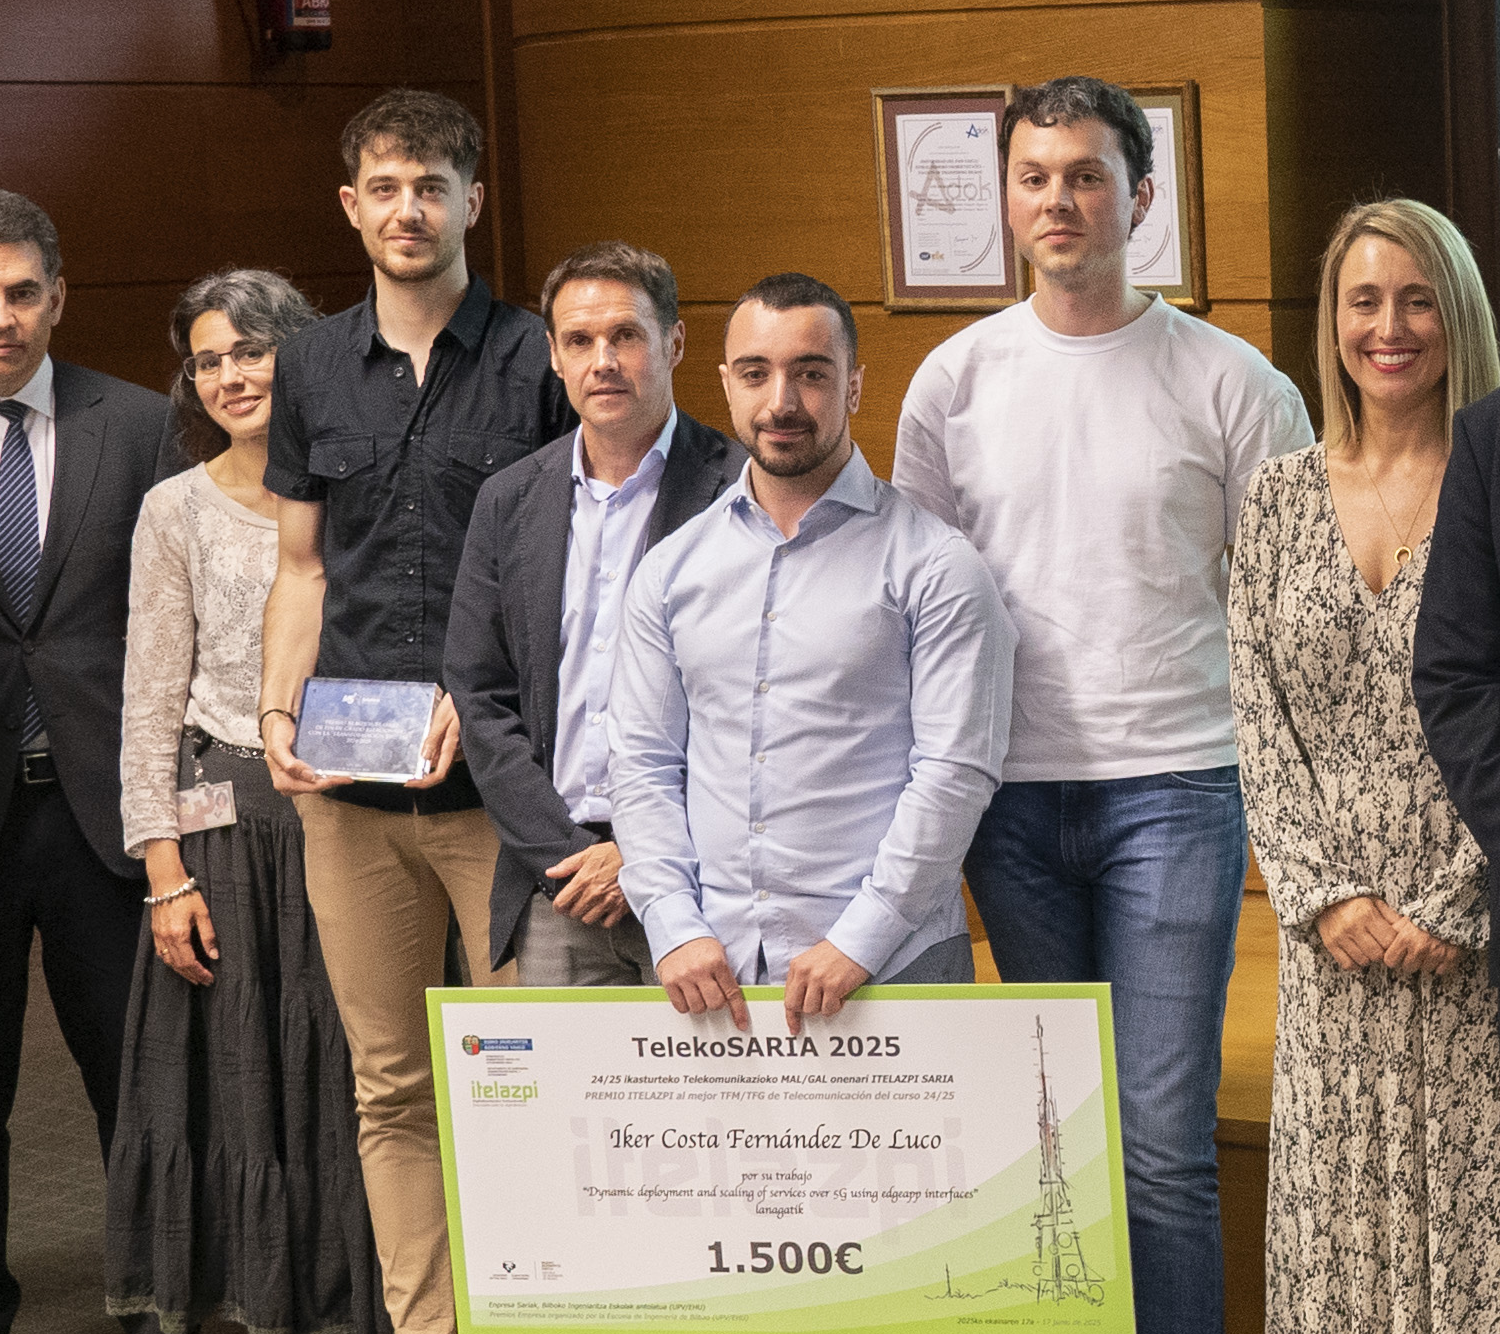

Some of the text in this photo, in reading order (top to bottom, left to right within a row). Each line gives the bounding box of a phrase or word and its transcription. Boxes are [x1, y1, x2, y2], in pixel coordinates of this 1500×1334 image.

[631, 1035, 902, 1059] TelekoSARIA 2025
[590, 1074, 954, 1084] 24/25 ikasturteko Telekomunikazioko MAL/GAL onenari ITELAZPI SARIA
[471, 1080, 538, 1102] itelazpi
[584, 1091, 955, 1102] PREMIO ITELAZPI al mejor TFM/TFG de Telecomunicación del curso 24/25
[609, 1124, 942, 1151] Iker Costa Fernández De Luco
[570, 1116, 967, 1244] itelazpi
[741, 1170, 813, 1183] por su trabajo
[637, 1186, 694, 1200] deployment
[697, 1187, 716, 1198] and
[719, 1187, 752, 1200] scaling
[755, 1187, 768, 1202] of
[770, 1189, 806, 1198] services
[809, 1190, 829, 1198] over
[832, 1189, 848, 1201] 5G
[851, 1188, 879, 1202] using
[881, 1188, 921, 1202] edgeapp
[755, 1202, 804, 1217] lanagatik
[708, 1241, 864, 1276] 1.500€
